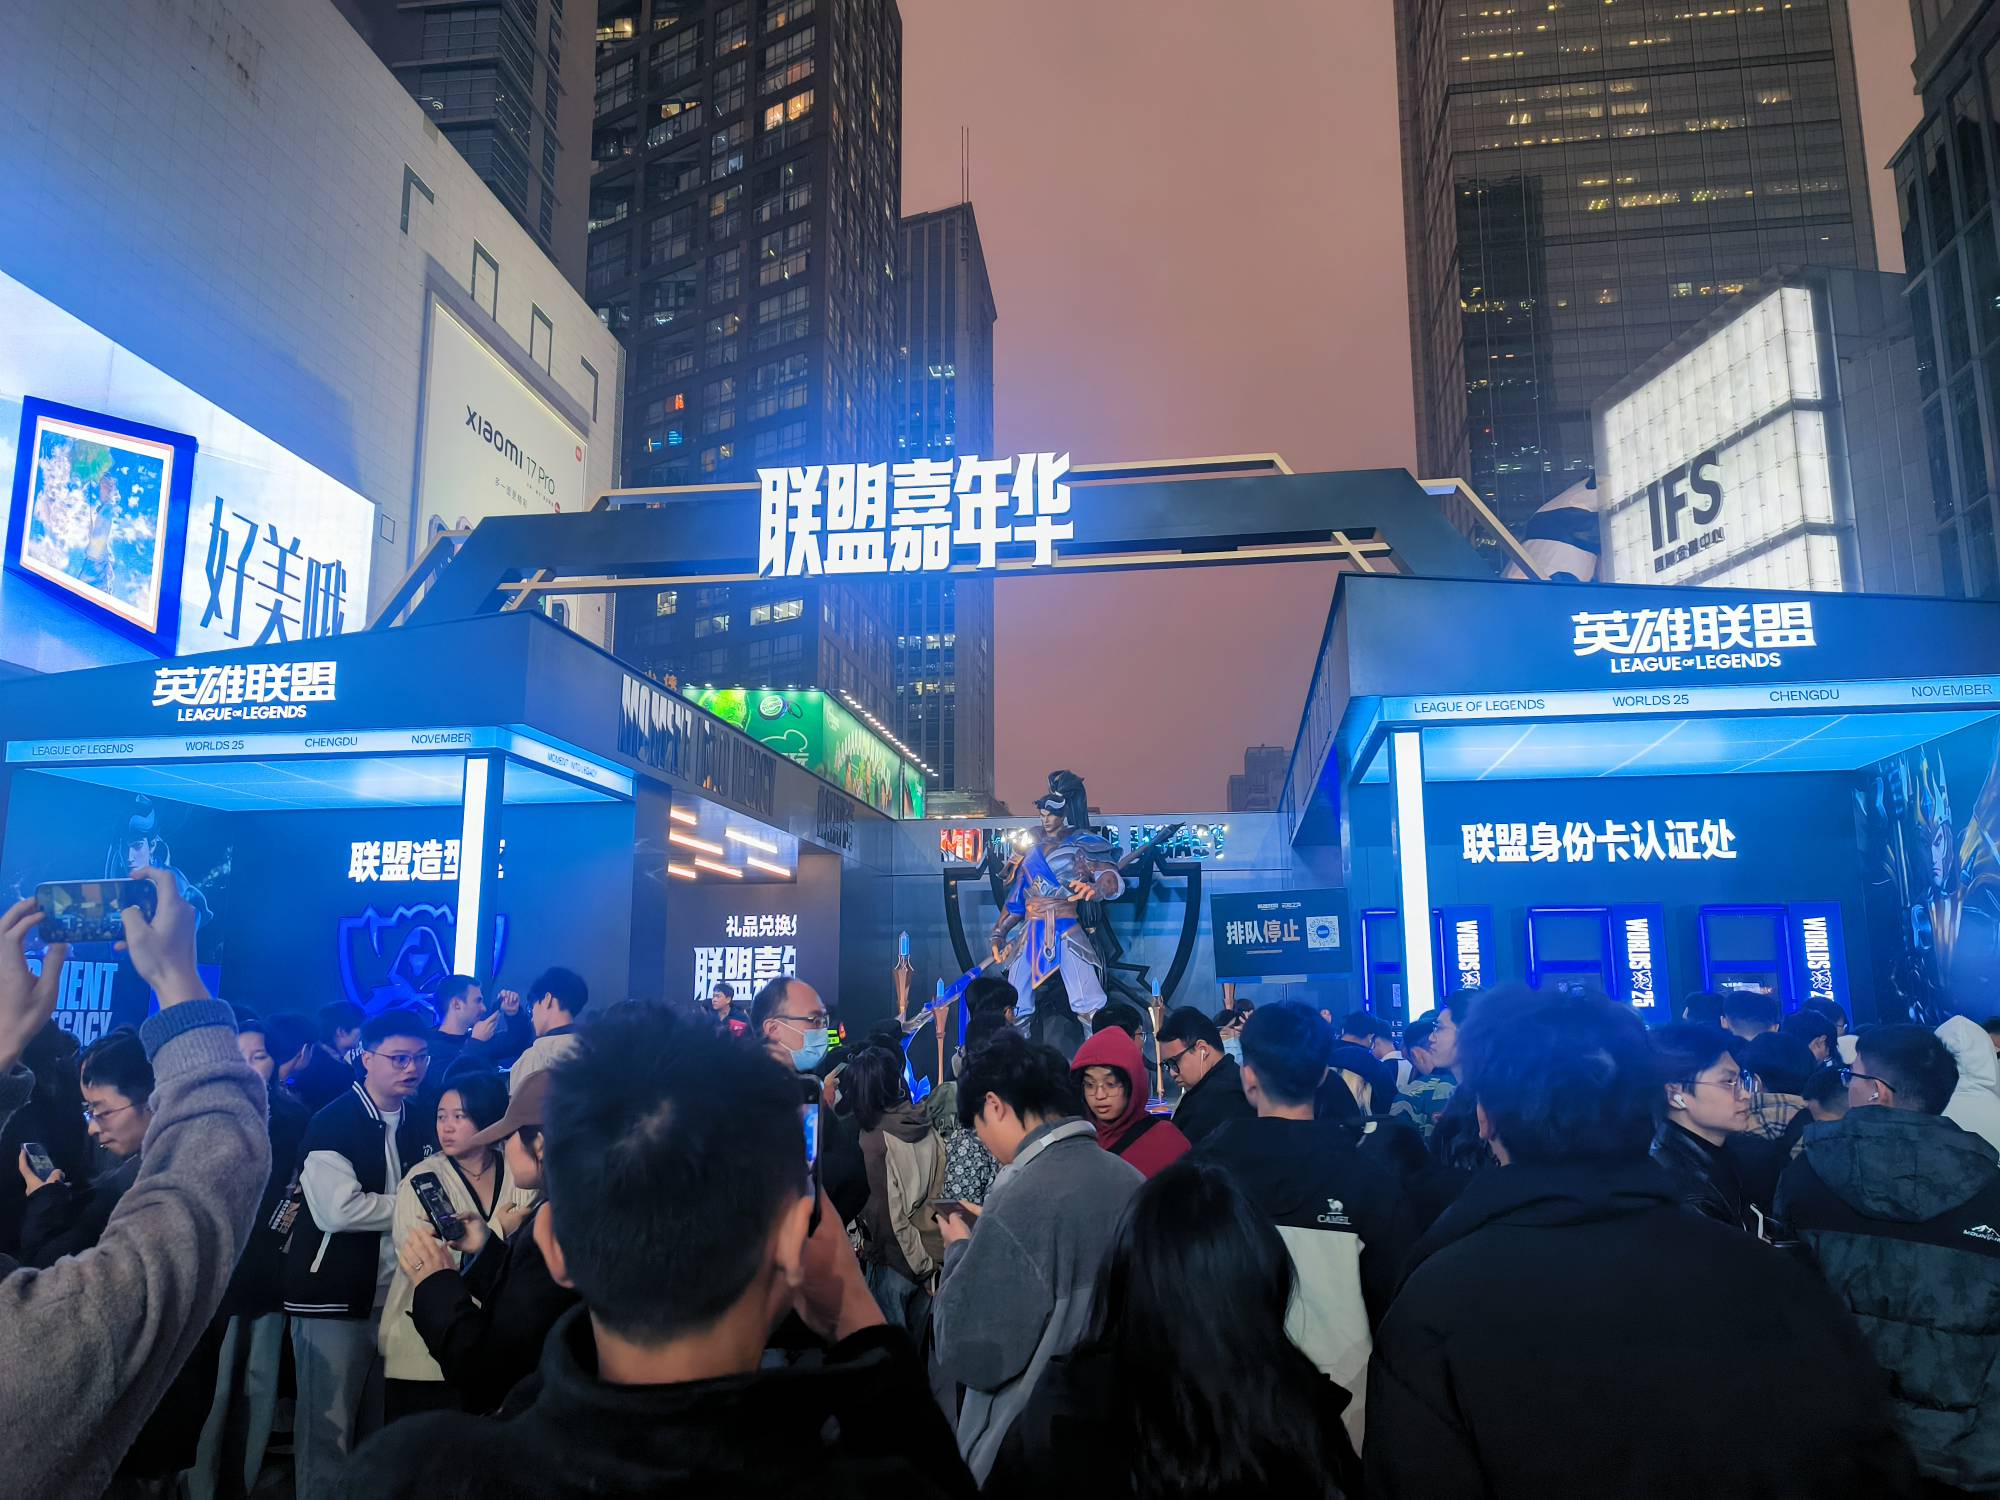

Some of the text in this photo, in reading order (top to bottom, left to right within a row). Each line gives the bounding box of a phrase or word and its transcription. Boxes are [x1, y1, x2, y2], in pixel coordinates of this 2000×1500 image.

[526, 456, 537, 478] 17
[538, 466, 555, 495] Pro
[757, 452, 1074, 577] 联盟嘉年华
[1647, 450, 1722, 552] IFS
[200, 496, 347, 646] 好美哦
[1571, 601, 1817, 657] 英雄联盟
[1610, 656, 1682, 674] LEAGUE
[1695, 652, 1782, 671] LEGENDS
[151, 661, 337, 707] 英雄联盟
[1769, 689, 1840, 702] CHENGDU
[1911, 684, 1993, 698] NOVEMBER
[177, 707, 233, 722] LEAGUE
[243, 704, 307, 720] LEGENDS
[1414, 699, 1545, 713] LEAGUE OF LEGENDS
[1612, 694, 1690, 707] WORLDS 25
[32, 743, 134, 756] LEAGUE OF LEGENDS
[185, 740, 245, 751] WORLDS 25
[304, 736, 358, 748] CHENGDU
[411, 733, 472, 744] NOVEMBER
[1461, 819, 1737, 863] 联盟身份卡认证处
[348, 839, 506, 883] 联盟造型
[1226, 919, 1301, 945] 排队停止
[1456, 920, 1481, 971] WORLDS
[1625, 918, 1655, 1008] WORLDS 25
[1803, 917, 1835, 1002] WORLDS 2
